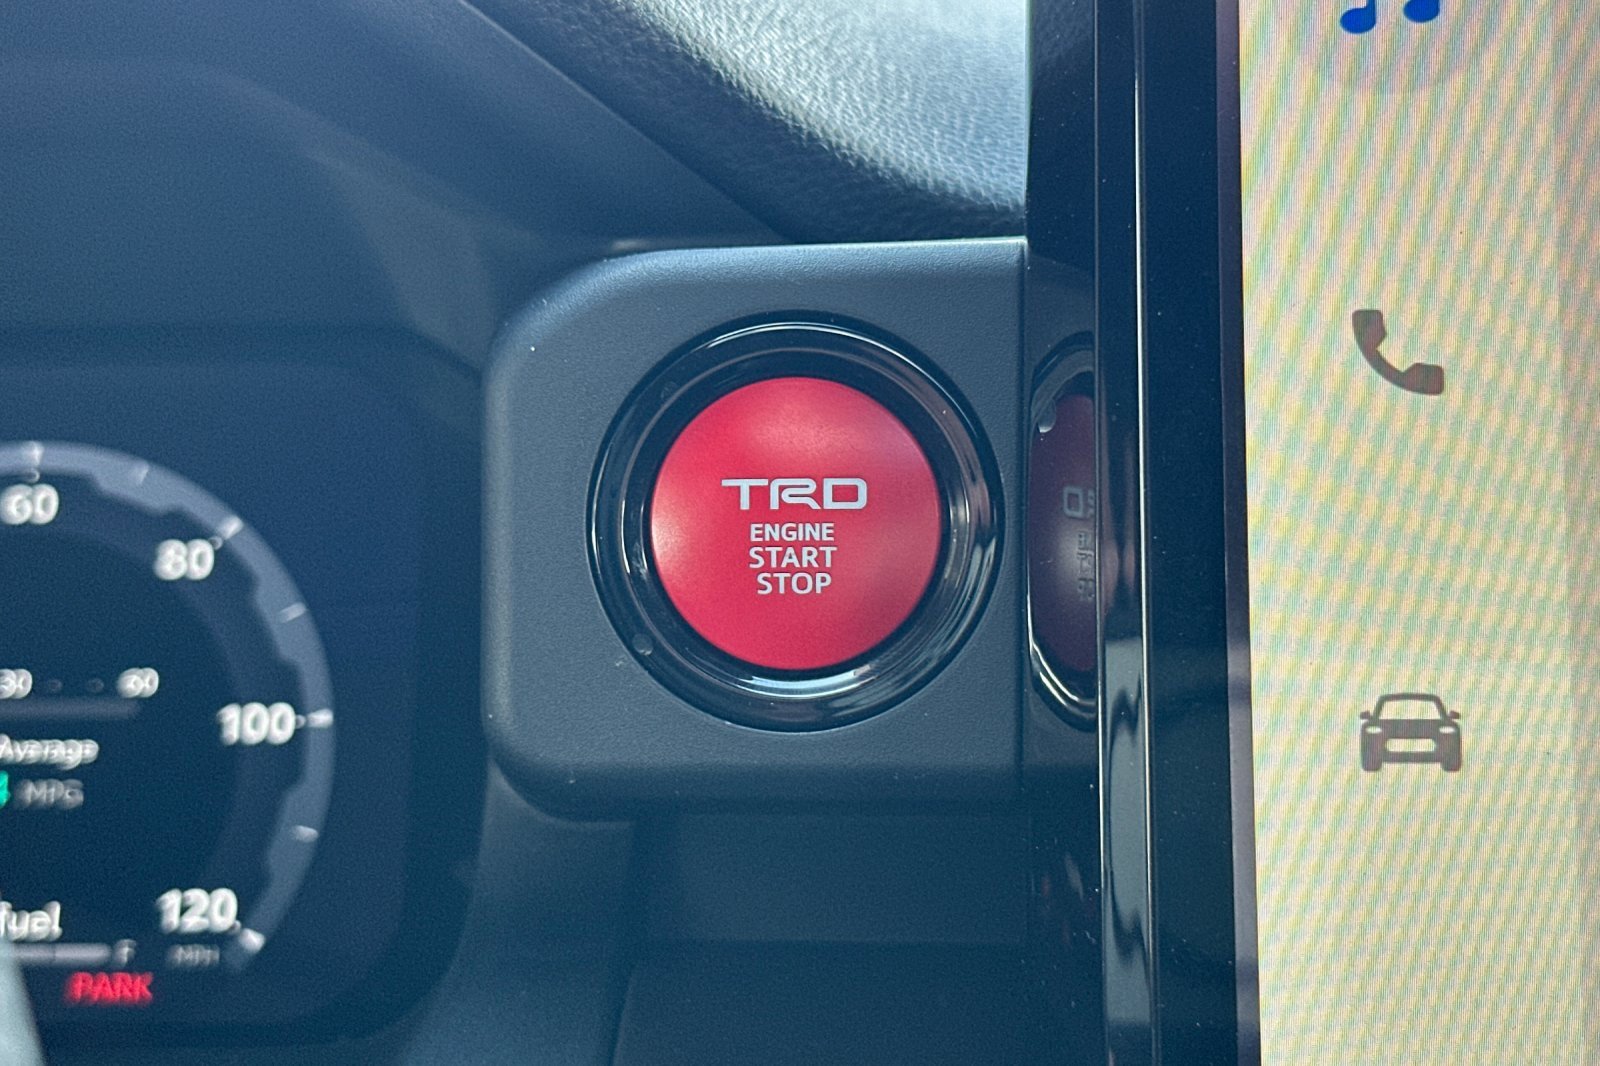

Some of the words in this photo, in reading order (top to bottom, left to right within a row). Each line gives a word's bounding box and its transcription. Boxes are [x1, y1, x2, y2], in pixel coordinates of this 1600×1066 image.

[0, 484, 59, 525] 60
[721, 478, 867, 511] TRD
[750, 522, 835, 542] ENGINE
[153, 538, 214, 581] 80
[749, 546, 838, 568] START
[757, 572, 832, 594] STOP
[219, 702, 297, 746] 100
[0, 734, 99, 770] Average
[156, 888, 238, 934] 120
[67, 972, 153, 1004] PARK
